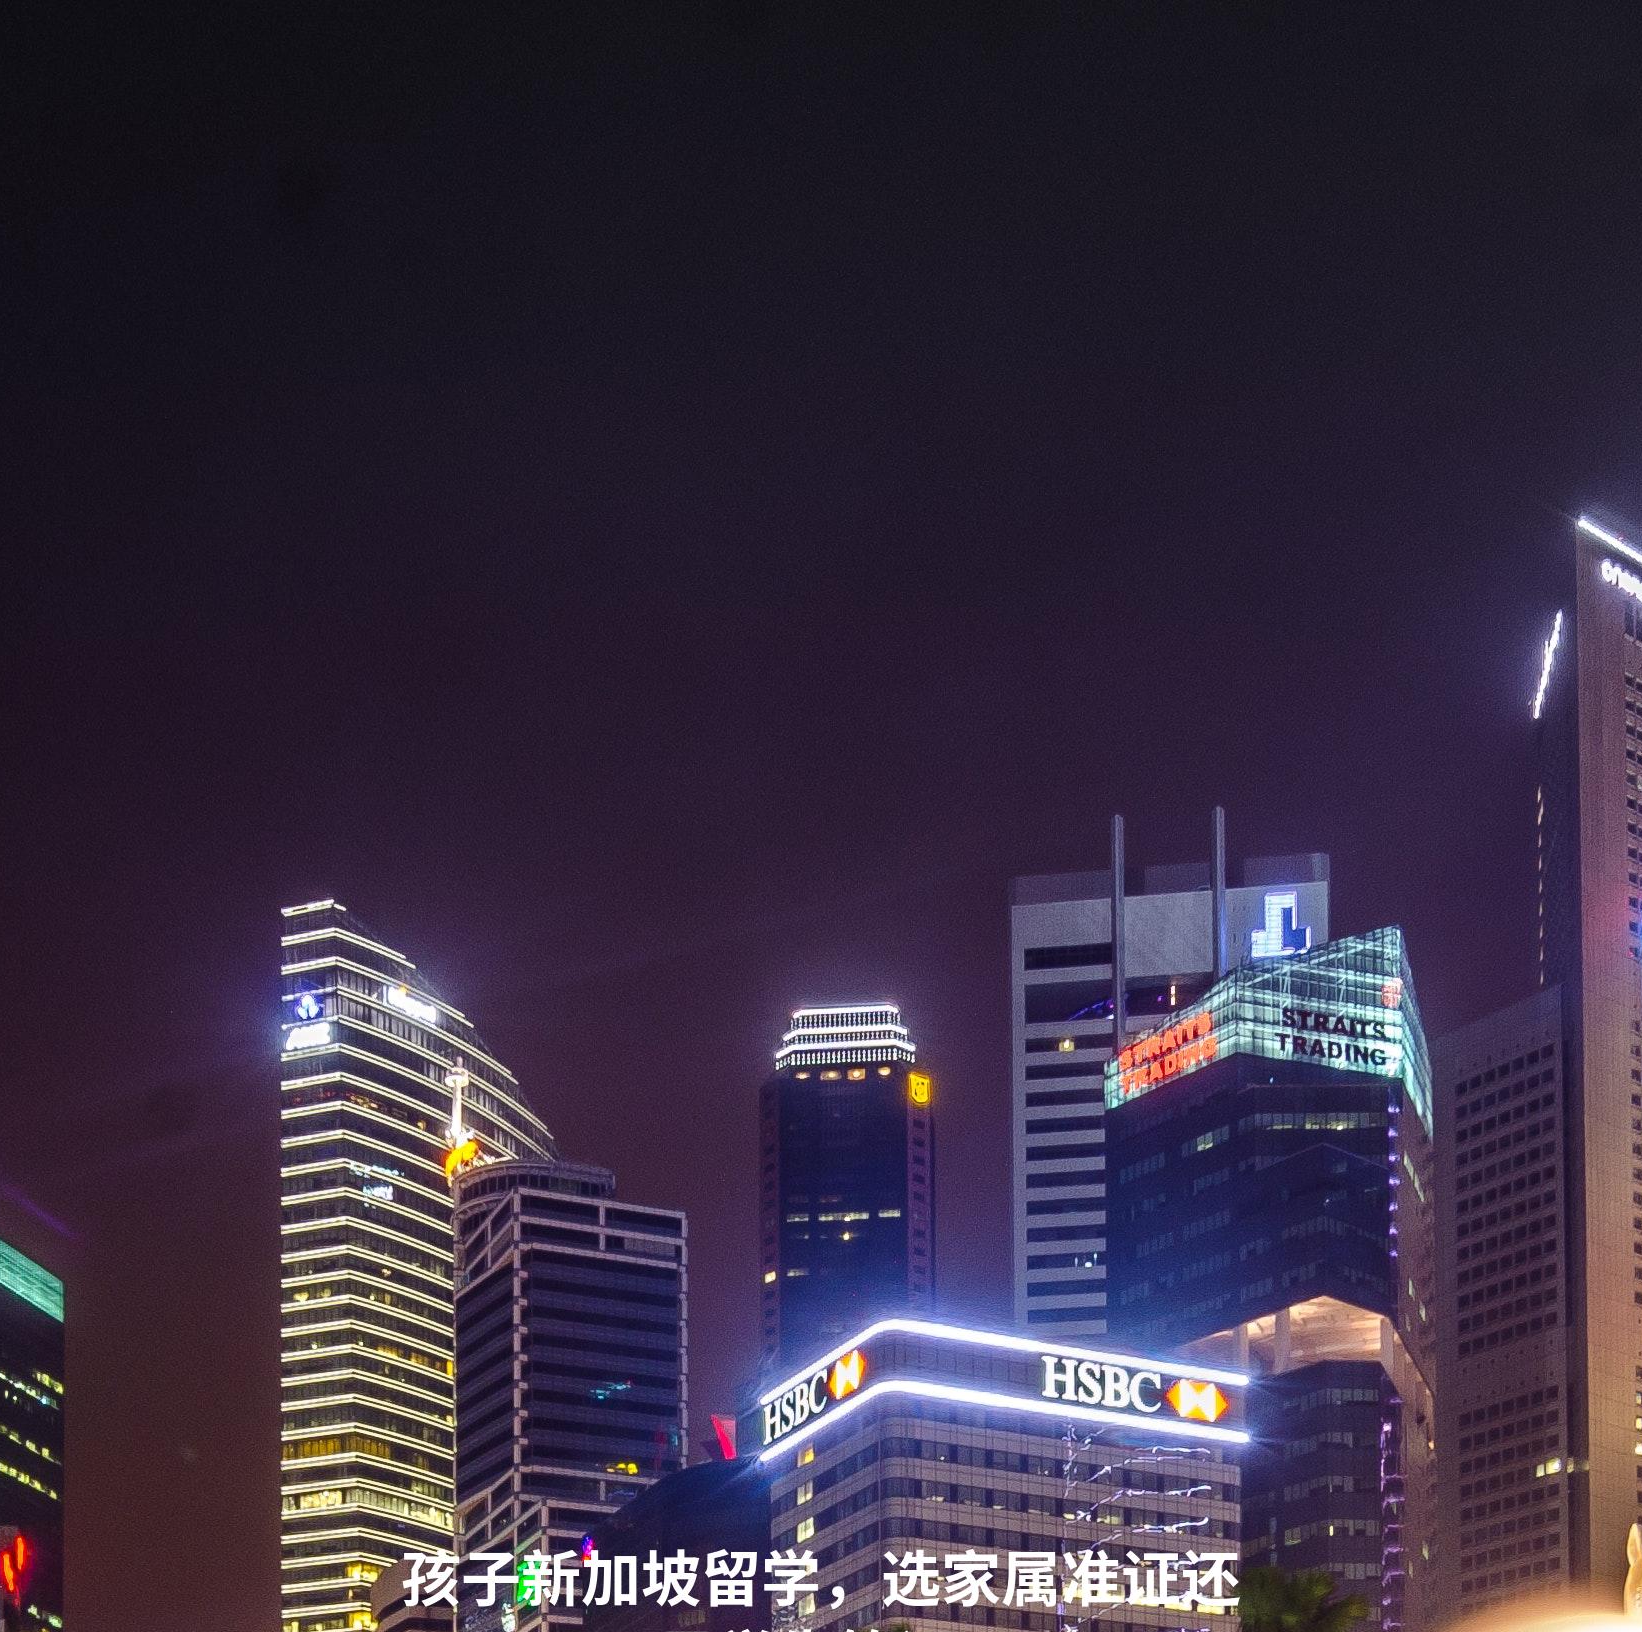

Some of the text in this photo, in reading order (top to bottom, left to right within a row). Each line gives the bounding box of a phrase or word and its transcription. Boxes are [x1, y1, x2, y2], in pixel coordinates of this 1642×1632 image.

[1118, 1011, 1214, 1071] STRAITS
[1275, 1032, 1387, 1066] TRADING
[1282, 1007, 1386, 1039] STRAITS
[1119, 1035, 1218, 1095] TRADING
[763, 1370, 829, 1445] HSBC
[1041, 1355, 1162, 1414] HSBC
